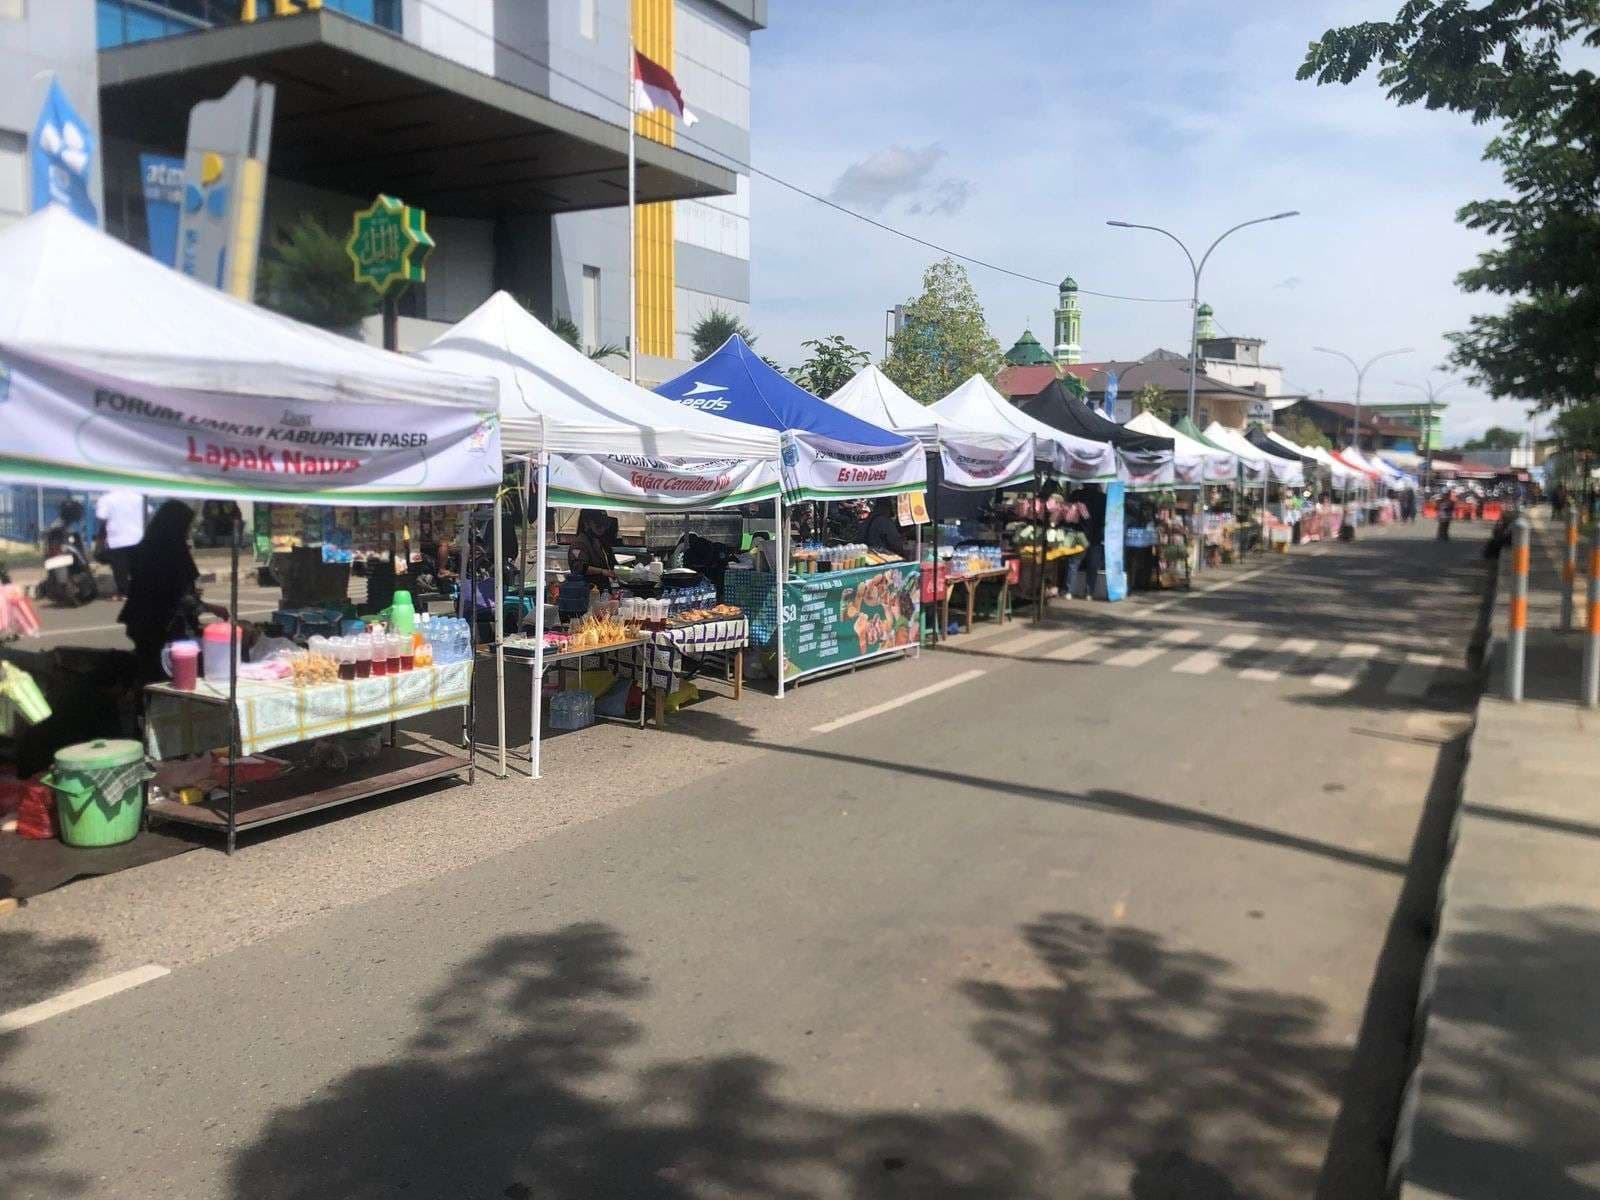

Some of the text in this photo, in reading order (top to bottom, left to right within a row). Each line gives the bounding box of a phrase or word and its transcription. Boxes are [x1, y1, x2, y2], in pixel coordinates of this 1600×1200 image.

[266, 427, 378, 448] KABUPATEN
[380, 432, 428, 448] PASER
[187, 435, 275, 475] Lapak
[838, 467, 850, 482] Es
